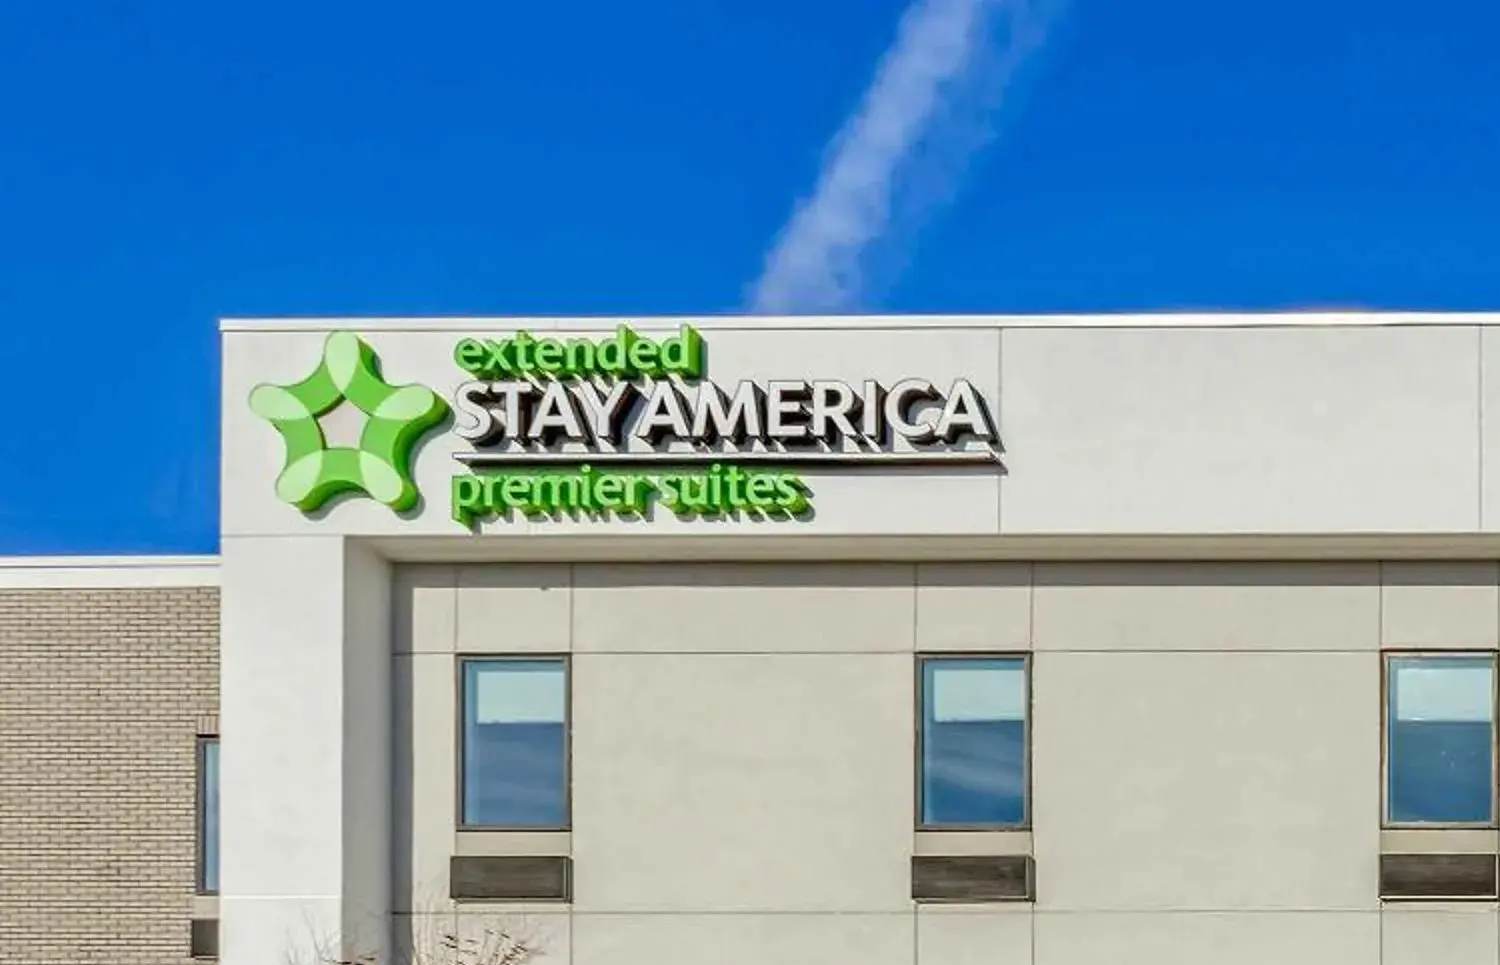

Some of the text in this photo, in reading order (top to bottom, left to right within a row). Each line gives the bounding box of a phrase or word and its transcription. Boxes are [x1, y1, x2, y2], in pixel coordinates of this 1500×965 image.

[454, 324, 692, 371] extended
[453, 377, 990, 439] STAY AMERICA
[455, 463, 800, 523] premier suites
